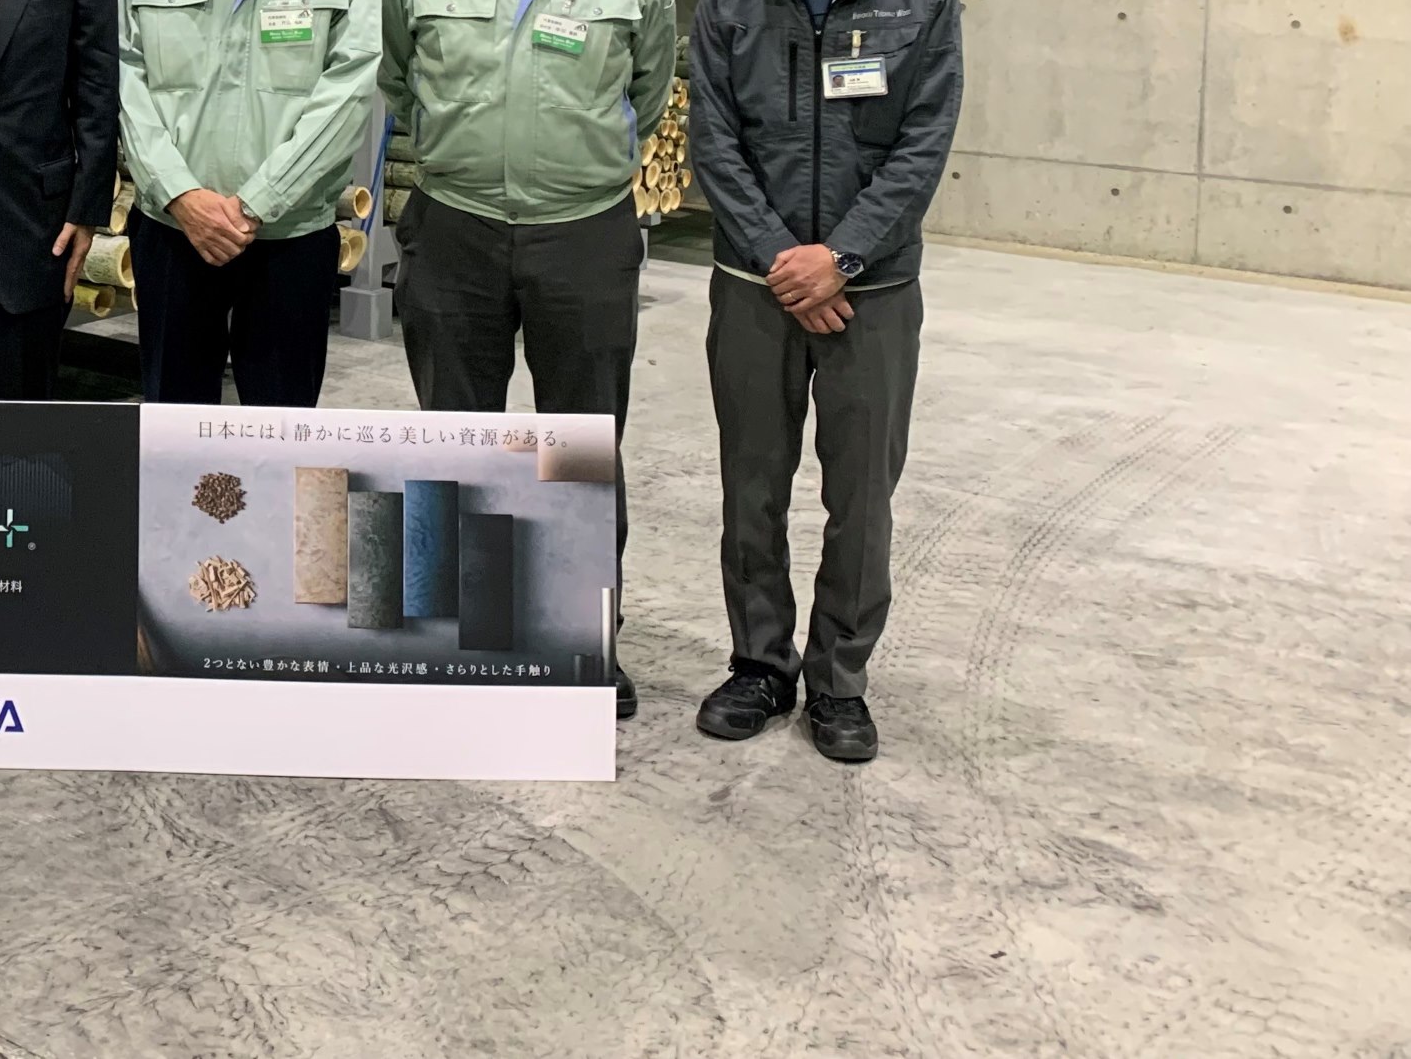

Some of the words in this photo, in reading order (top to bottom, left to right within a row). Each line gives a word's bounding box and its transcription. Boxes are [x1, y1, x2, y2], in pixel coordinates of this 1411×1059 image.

[198, 420, 568, 449] 日本には、静かに巡る美しい資源がある。
